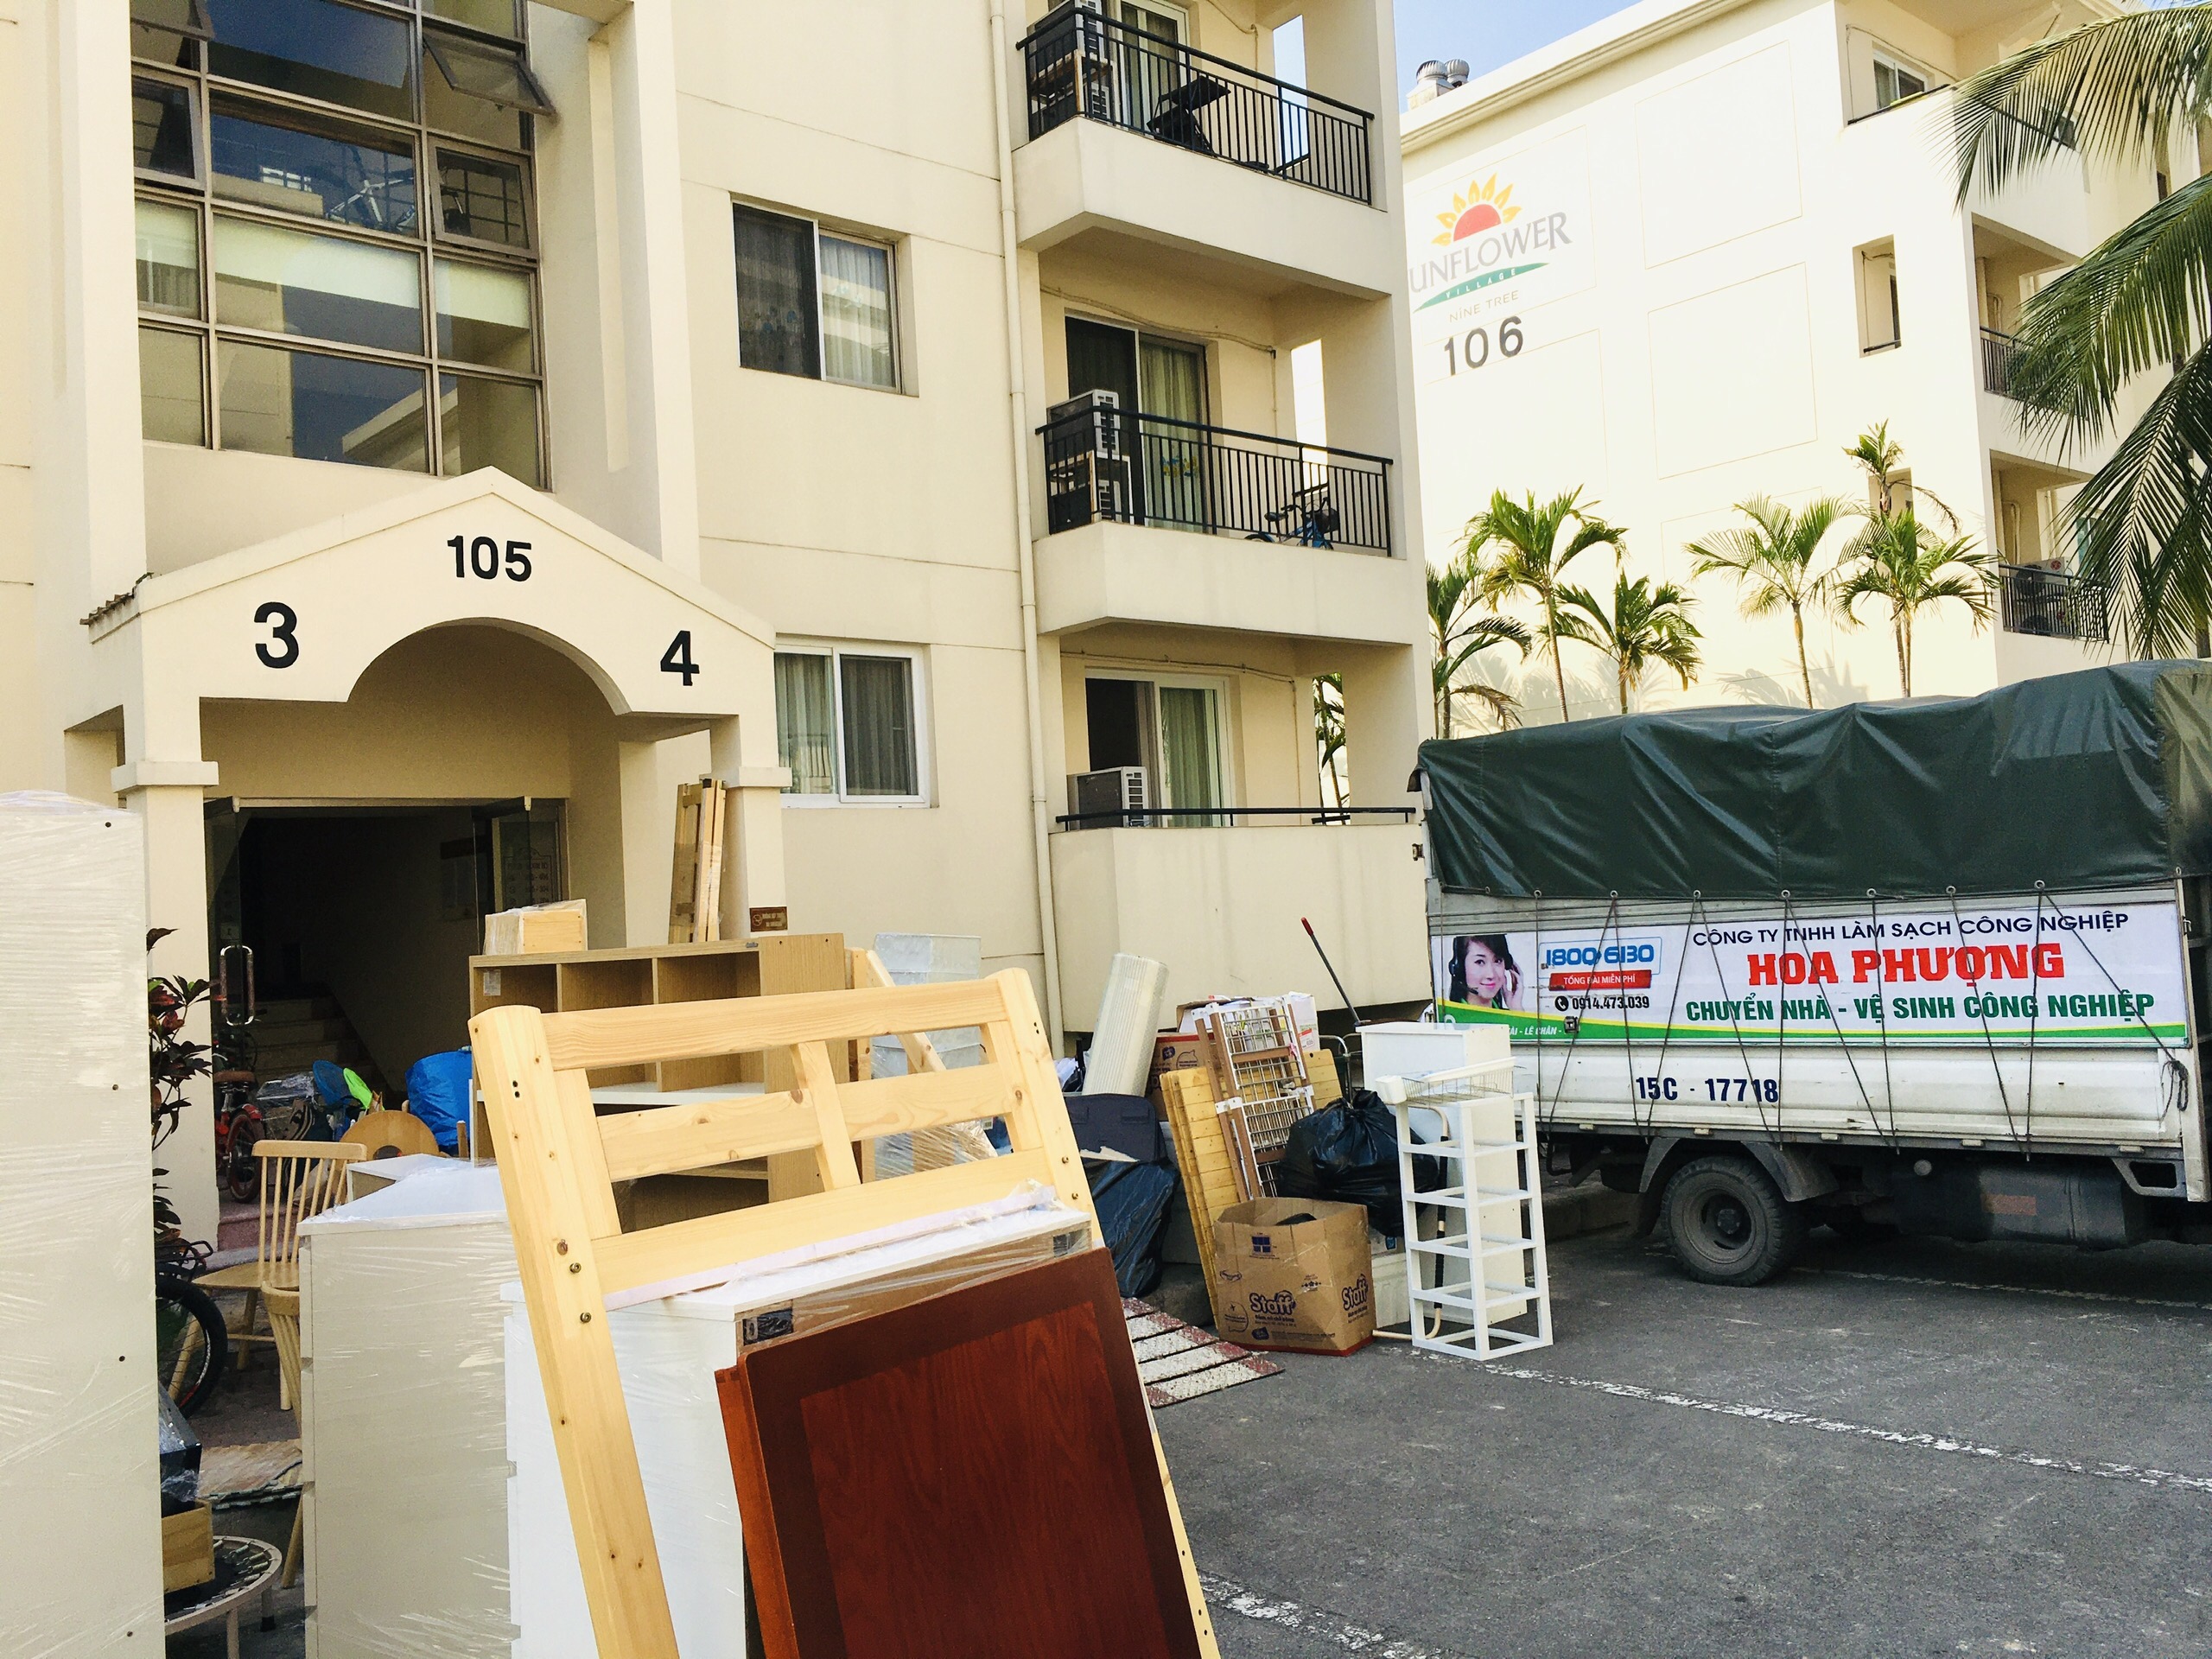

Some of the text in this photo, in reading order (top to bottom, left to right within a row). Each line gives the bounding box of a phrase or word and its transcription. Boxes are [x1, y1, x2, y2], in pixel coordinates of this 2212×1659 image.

[1446, 268, 1516, 299] VILLAGE
[1485, 289, 1519, 309] TREE
[1444, 316, 1524, 376] 106
[447, 535, 532, 582] 105
[253, 601, 300, 670] 3
[659, 630, 700, 686] 4
[1693, 911, 2129, 946] CÔNG TY TNHH LÀM SẠCH CÔNG NGHIỆP
[1623, 973, 1636, 983] PHÍ
[1747, 943, 2065, 988] HOA PHƯỢNG
[1572, 996, 1649, 1010] 0914.473.039
[1686, 992, 1774, 1020] CHUYỂN
[1781, 995, 1831, 1020] NHÀ
[1853, 994, 1885, 1023] VỆ
[1892, 996, 1955, 1019] SINH
[1963, 991, 2039, 1018] CÔNG
[2047, 989, 2155, 1022] NGHIỆP
[1524, 1025, 1535, 1035] LÊ
[1636, 1077, 1678, 1101] 15C
[1705, 1078, 1779, 1103] 17718
[1249, 1291, 1296, 1315] Staff
[1342, 1274, 1369, 1311] Staff
